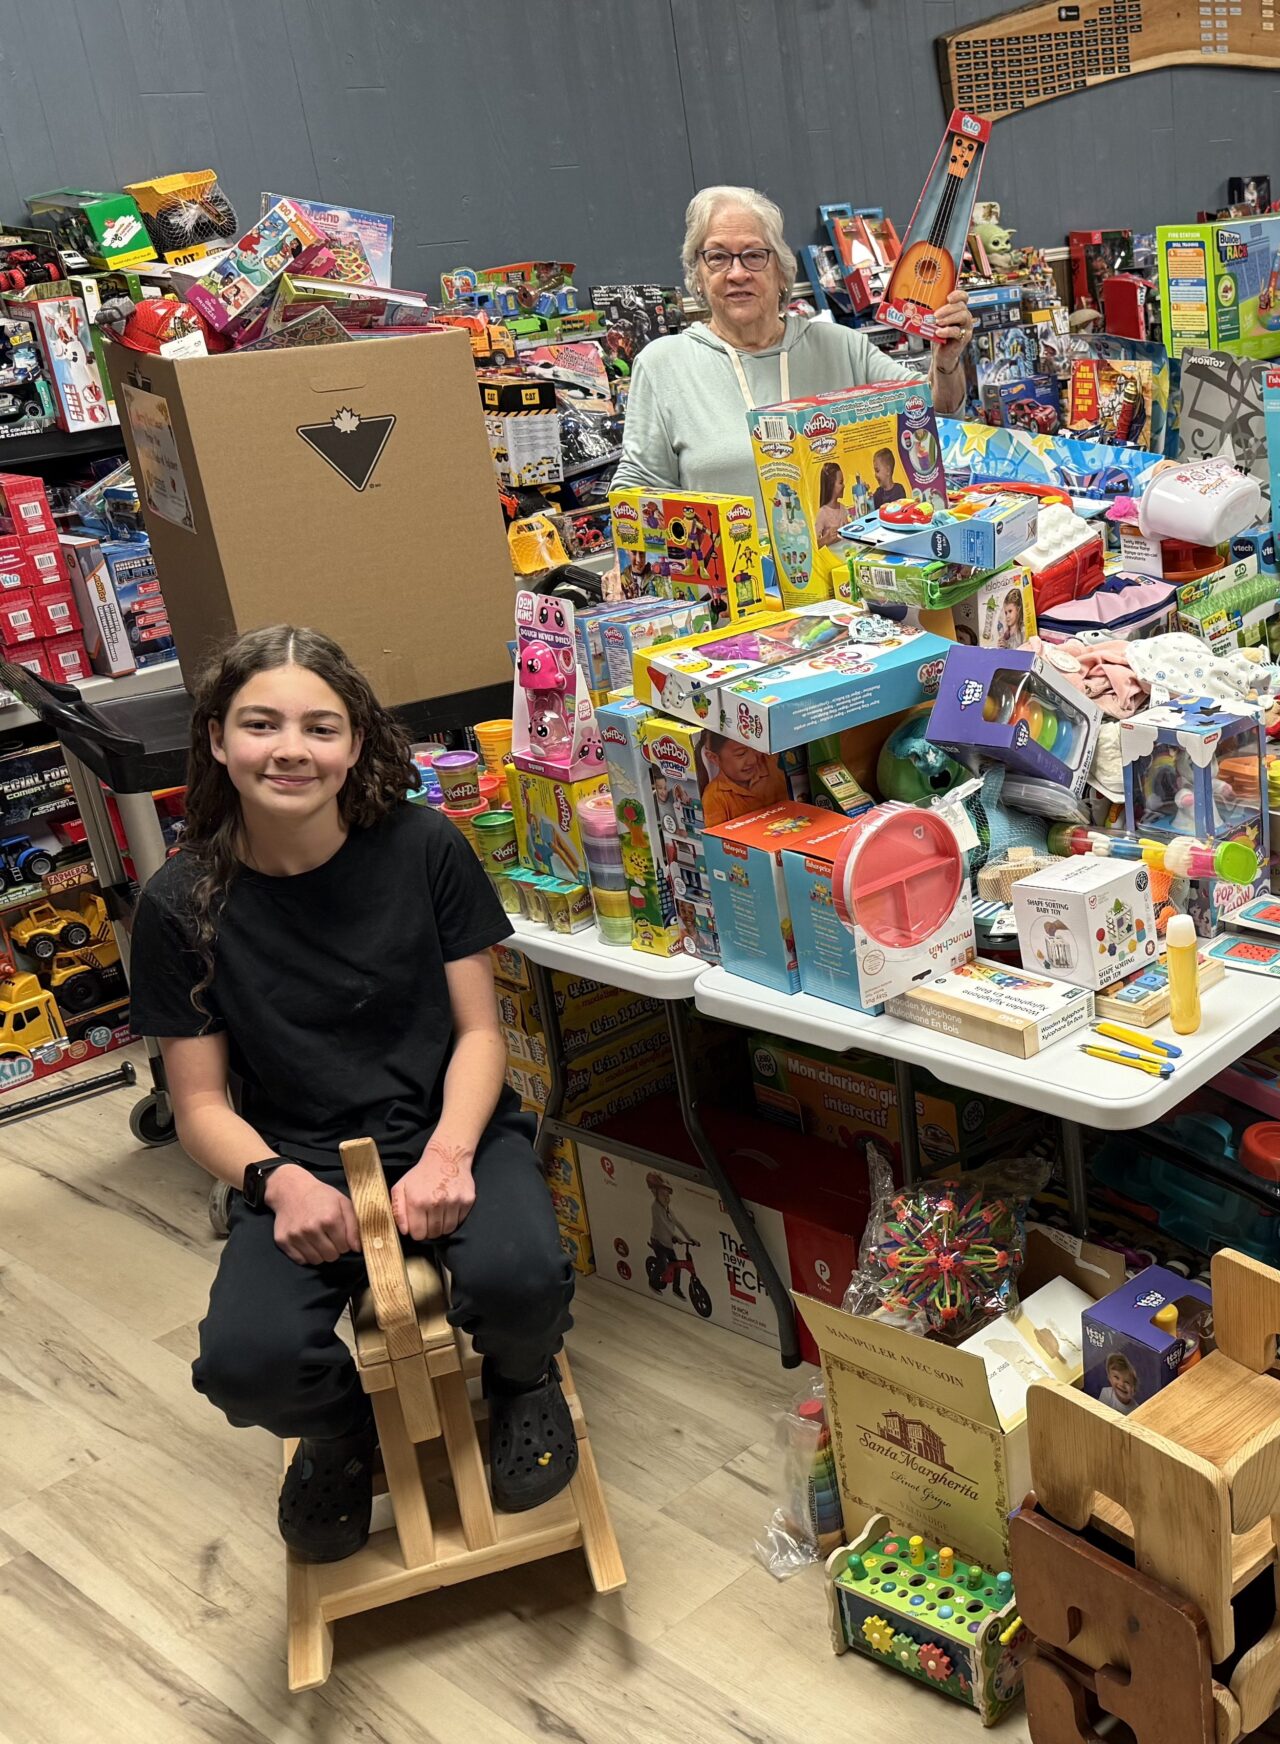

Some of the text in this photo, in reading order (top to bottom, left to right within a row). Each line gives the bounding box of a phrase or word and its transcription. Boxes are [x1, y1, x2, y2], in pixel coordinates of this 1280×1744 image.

[963, 118, 980, 132] KID
[277, 201, 315, 242] 100 PUZZLE
[1219, 232, 1241, 245] Builder
[174, 255, 196, 266] CAT
[1219, 245, 1248, 262] TRACK
[888, 309, 905, 323] KID
[1188, 356, 1225, 368] MONTOY
[62, 383, 84, 422] FIRE
[487, 392, 496, 402] CAT
[525, 392, 536, 401] CAT
[804, 415, 836, 437] Play-Doh
[612, 504, 638, 522] Play-Doh
[726, 504, 752, 521] Play-Doh
[0, 573, 20, 585] KID
[520, 628, 537, 638] DOUGH
[538, 631, 555, 642] NEVER
[1211, 641, 1231, 655] Green
[601, 729, 627, 745] Play-Doh
[652, 742, 689, 764] Play-Doh
[42, 764, 69, 784] FOR
[445, 783, 478, 801] Play-Do
[556, 787, 571, 832] Play-Doh
[724, 805, 786, 831] fisher-price
[807, 821, 853, 845] fisher-pri
[722, 842, 748, 856] fisher-price
[48, 864, 88, 886] FARMER'S
[806, 860, 832, 874] fisher-price
[61, 876, 83, 890] TOY
[1215, 885, 1234, 904] POP
[1027, 898, 1069, 912] SHAPE SORTING
[1036, 907, 1062, 916] BABY TOY
[928, 929, 973, 960] munchkin
[1098, 956, 1135, 979] SHAPE SORTING
[1099, 970, 1122, 986] BABY TOY
[961, 988, 1040, 1016] Wooden Xylophone
[975, 985, 1050, 1011] Xylophone En Bois
[889, 1004, 960, 1035] Xylophone En Bois
[920, 1003, 963, 1025] Xylophone
[1041, 1006, 1085, 1035] Wooden Xylophone
[94, 1029, 109, 1040] 22
[1041, 1027, 1066, 1041] Xylophone
[1074, 1014, 1084, 1026] Bois
[0, 1058, 32, 1082] KID
[788, 1057, 816, 1080] Mon
[818, 1064, 865, 1098] chariot
[824, 1094, 888, 1128] interactif
[719, 1231, 749, 1258] The
[722, 1251, 746, 1268] new
[724, 1262, 769, 1297] TECH
[1086, 1326, 1105, 1341] Itsy
[1089, 1337, 1104, 1348] Tots
[826, 1325, 964, 1390] MANIPULER AVEC SOIN
[1166, 1347, 1182, 1367] Itsy
[859, 1430, 980, 1503] Santa Margherita
[890, 1469, 952, 1511] Pinot Grigio
